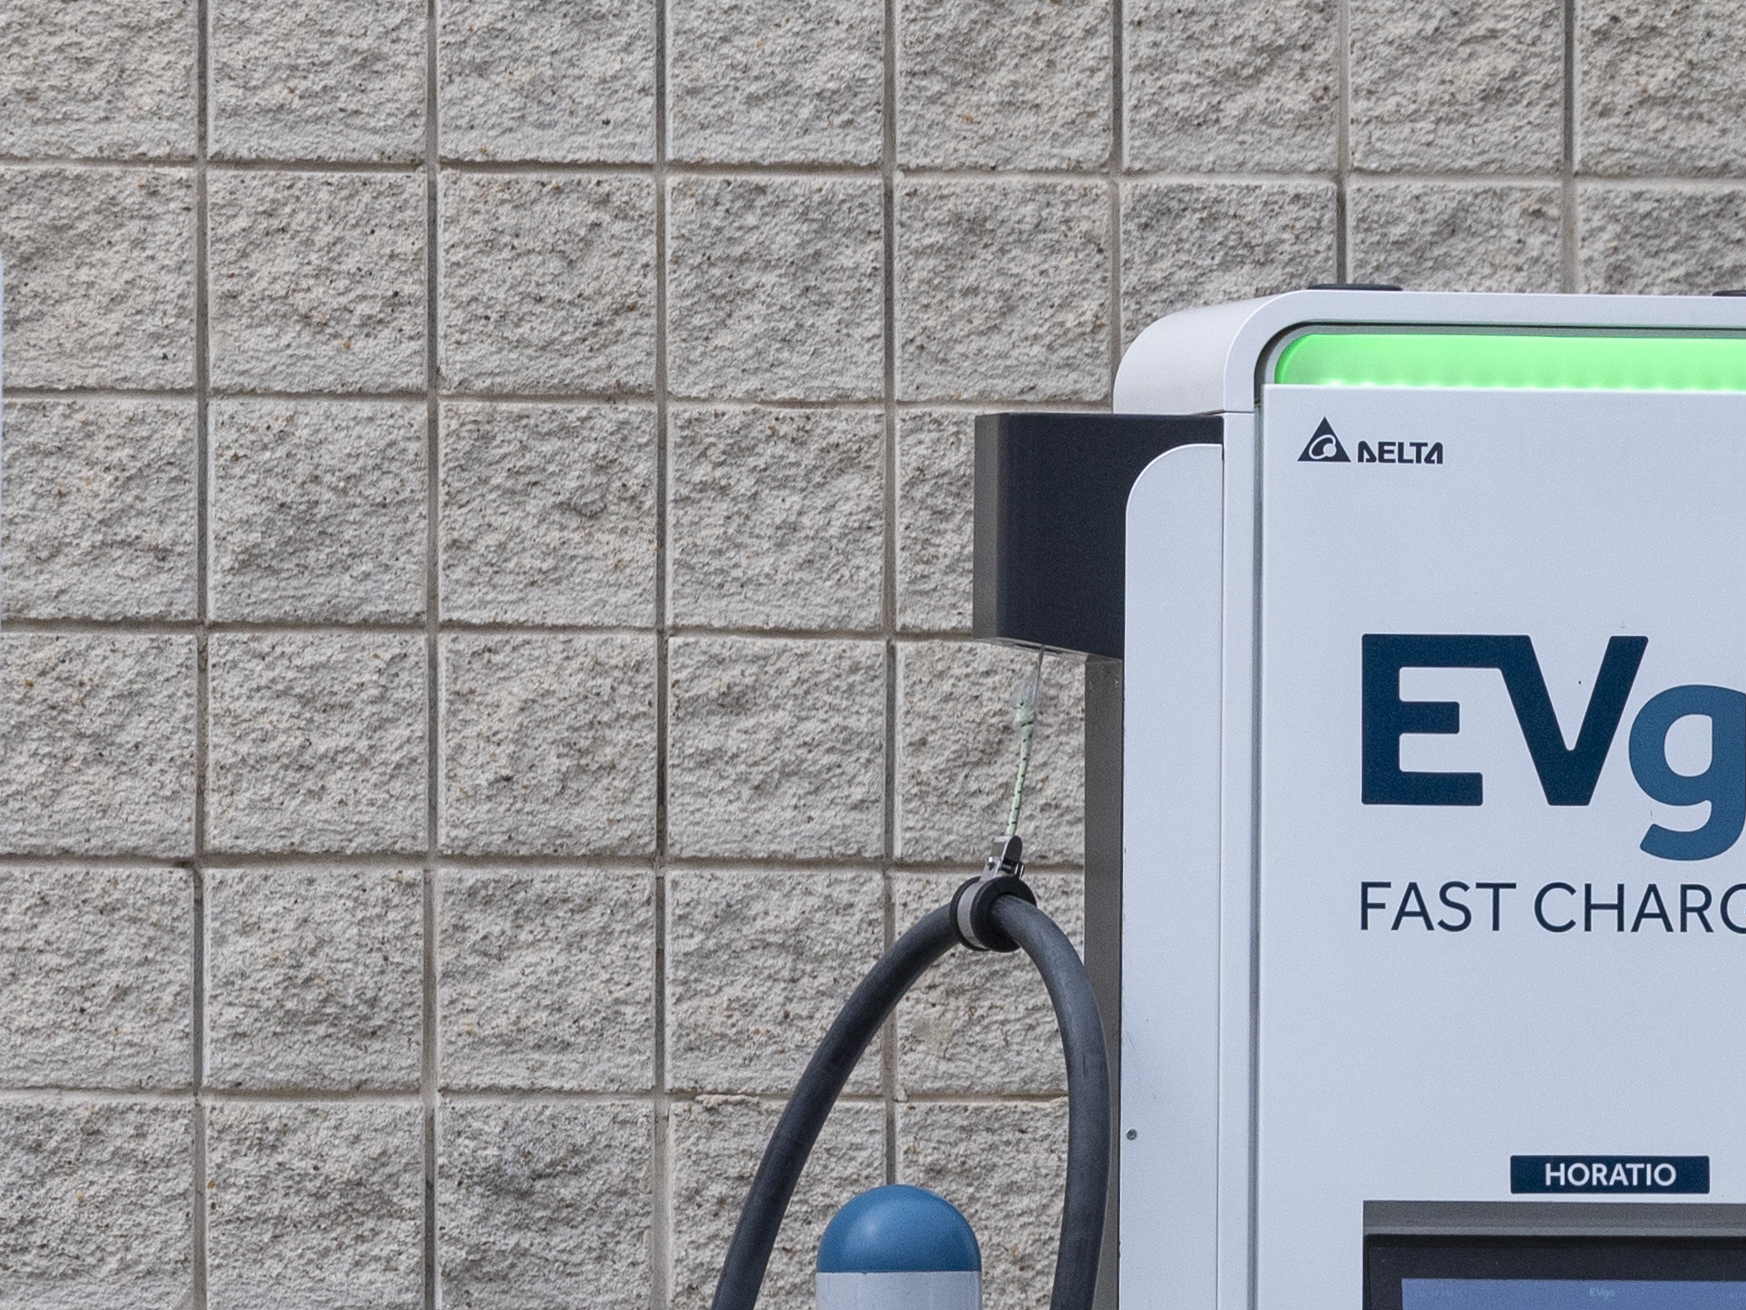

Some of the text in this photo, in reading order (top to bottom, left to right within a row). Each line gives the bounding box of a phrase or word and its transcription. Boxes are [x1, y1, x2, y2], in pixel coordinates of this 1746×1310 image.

[1357, 440, 1444, 465] DELTA
[1360, 881, 1517, 932] FAST
[1545, 1162, 1677, 1187] HORATIO
